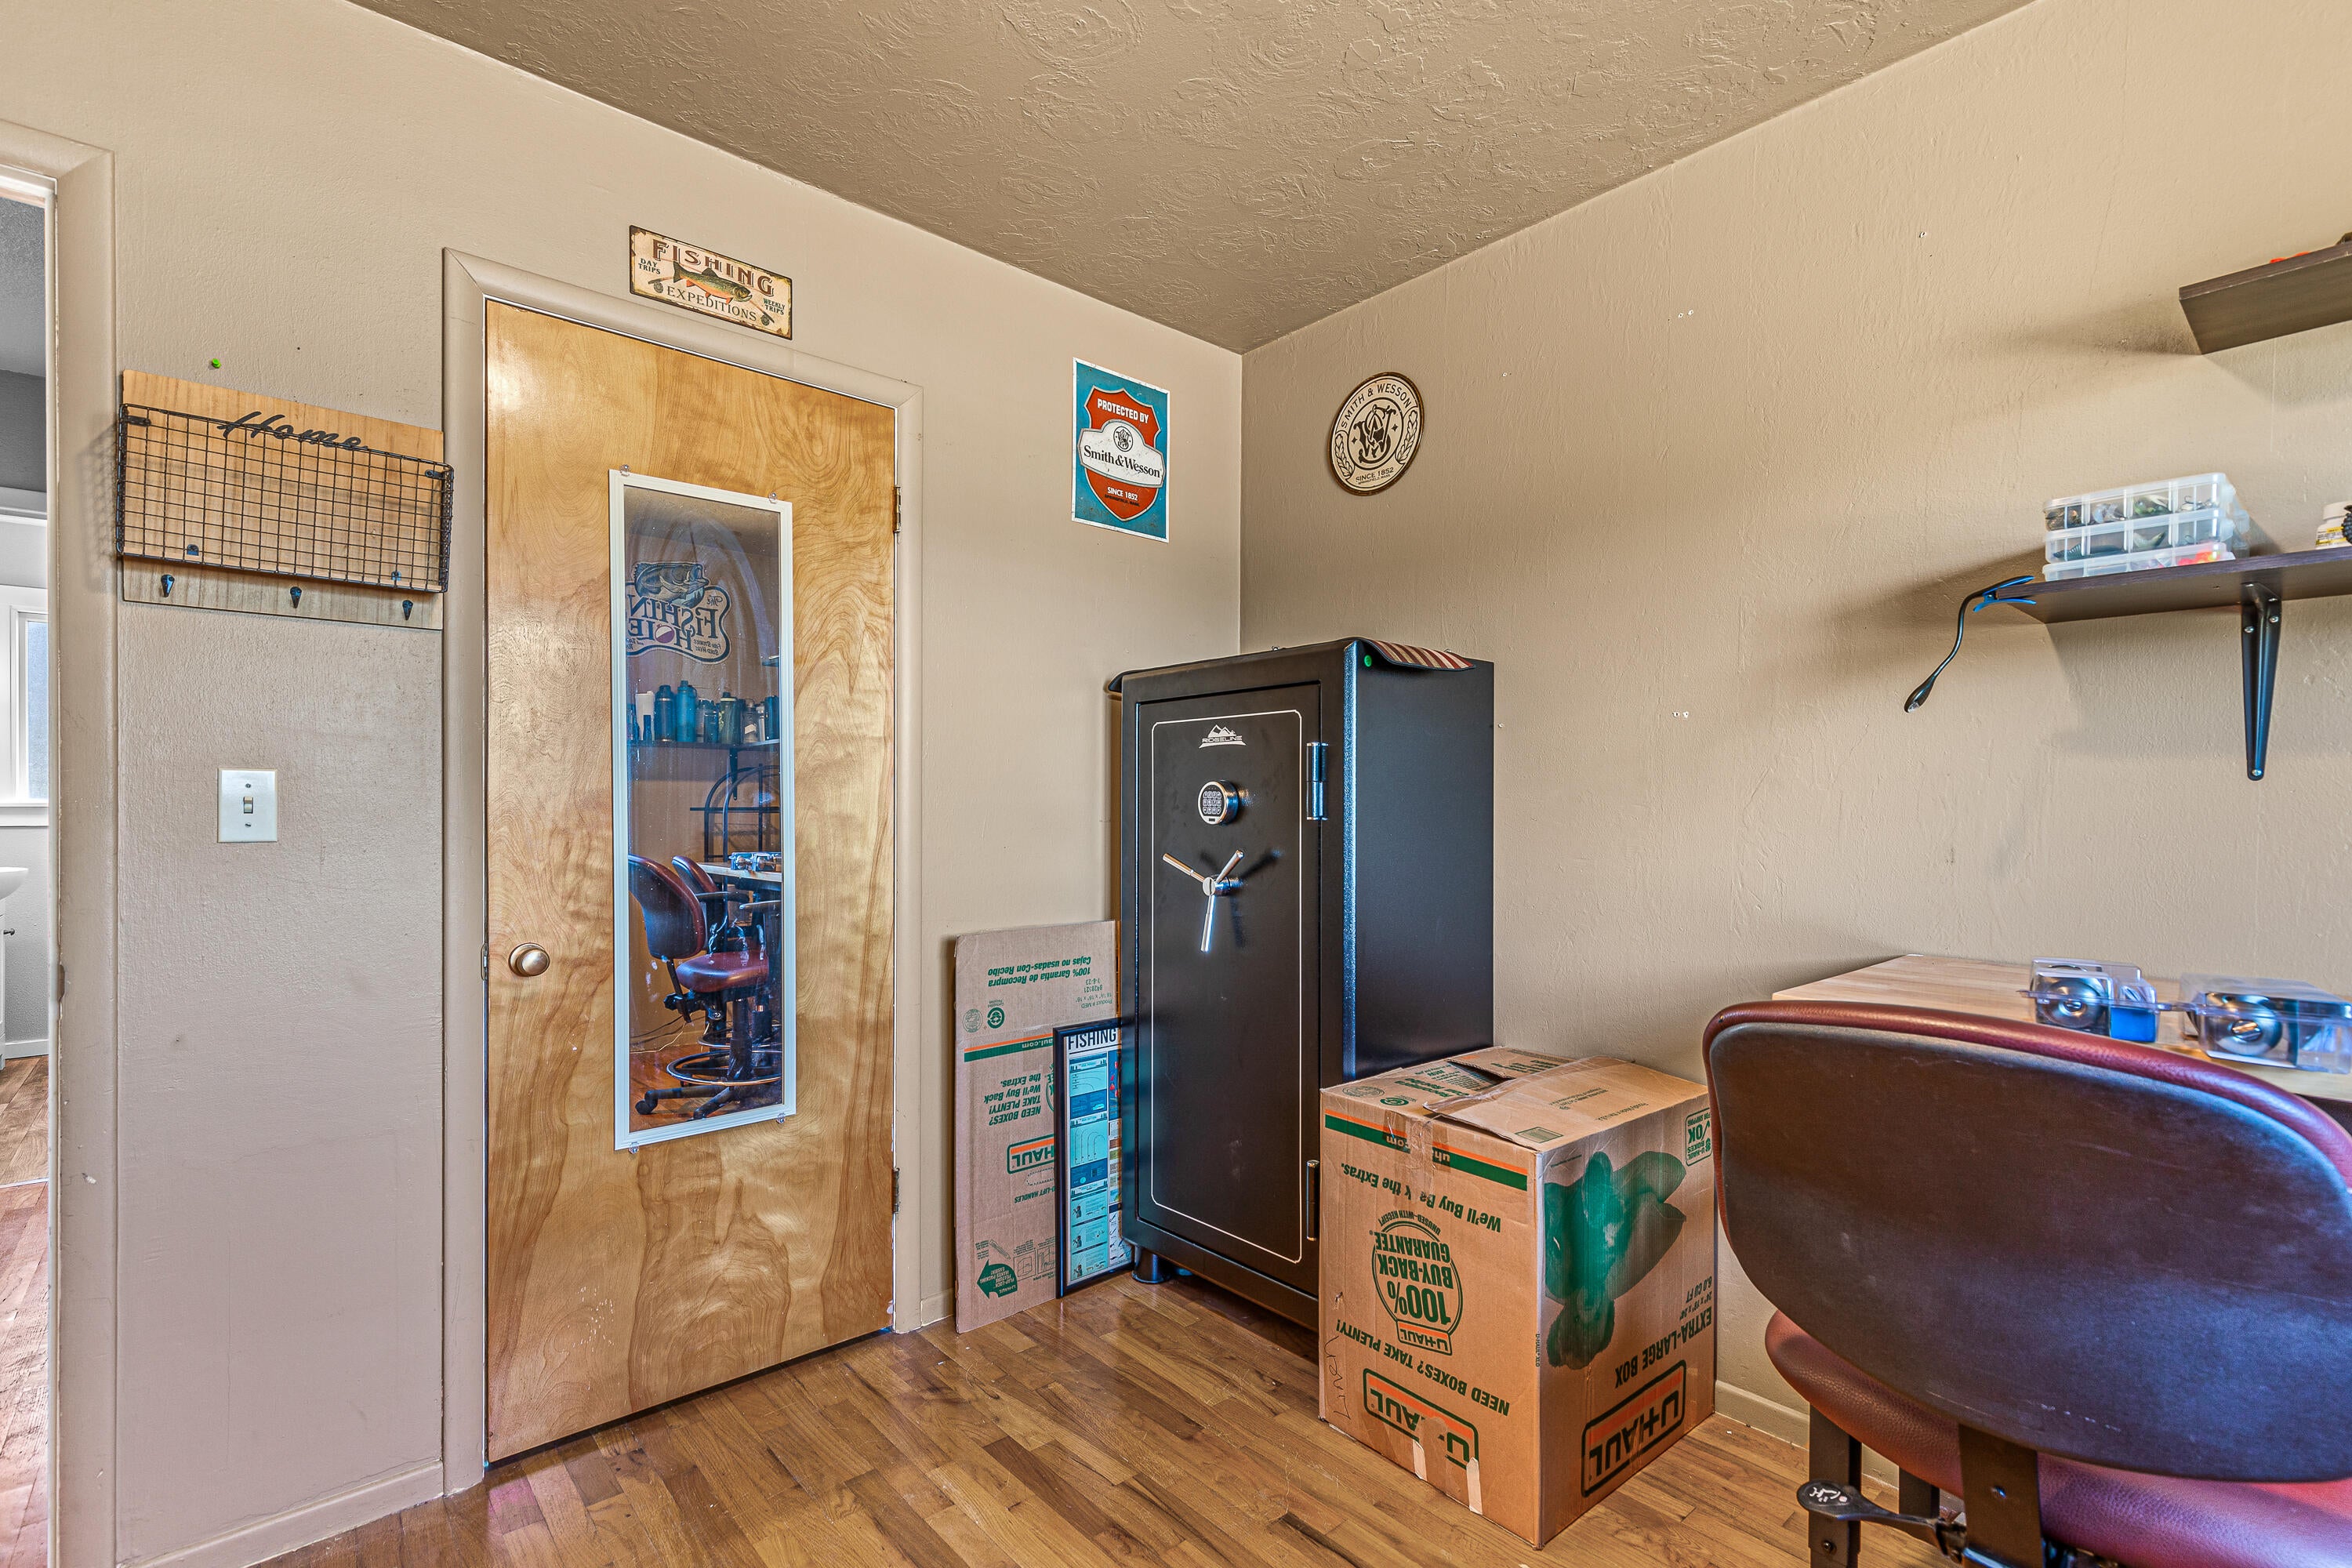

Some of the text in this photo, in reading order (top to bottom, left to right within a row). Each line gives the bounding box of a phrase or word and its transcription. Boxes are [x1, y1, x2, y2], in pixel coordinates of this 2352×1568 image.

[638, 263, 661, 275] TRIPS
[640, 257, 658, 268] DAY
[652, 238, 775, 297] FISHING
[666, 286, 757, 322] EXPEDITIONS
[763, 297, 786, 310] WEEKLY
[764, 304, 785, 316] TRIPS
[1097, 397, 1150, 425] PROTECTED BY
[1341, 383, 1412, 428] SMITH & WESSON
[217, 411, 368, 452] Home
[1356, 466, 1394, 482] SINCE 1852
[1107, 486, 1139, 502] SINCE 1852
[1062, 959, 1071, 967] no
[1073, 956, 1091, 967] Cajas
[988, 966, 1014, 977] Recibo
[988, 967, 1091, 989] 100% Garantía de Recompra
[1068, 1028, 1116, 1050] FISHING
[1000, 1076, 1027, 1087] Extras.
[1029, 1073, 1041, 1083] the
[984, 1092, 1004, 1104] Back
[1006, 1088, 1021, 1098] Buy
[1023, 1084, 1041, 1095] We'll
[989, 1095, 1041, 1114] TAKE PLENTY!
[989, 1105, 1041, 1126] NEED BOXES?
[1687, 1115, 1703, 1127] SHIPPING
[1688, 1124, 1703, 1143] OK
[1687, 1141, 1705, 1153] BOXES
[1687, 1148, 1705, 1160] U-HAUL
[1014, 1191, 1039, 1204] HANDLES
[1341, 1163, 1502, 1233] Extras. the Bak Buy We'll
[1377, 1210, 1399, 1227] RECEIPT
[1377, 1232, 1451, 1263] GUARANTEE
[980, 1275, 996, 1284] PACKING
[1376, 1253, 1454, 1290] BUY-BACK
[999, 1285, 1016, 1294] U-HAUL
[1686, 1276, 1712, 1303] FT CU 6.0
[1387, 1279, 1451, 1326] 100%
[1400, 1329, 1448, 1352] U-HAUL
[1614, 1306, 1712, 1389] BOX EXTRA-LARGE
[1336, 1319, 1511, 1417] PLENTY! TAKE BOXES? NEED
[1373, 1388, 1470, 1456] U-AUL
[1589, 1391, 1680, 1477] U-HAUL
